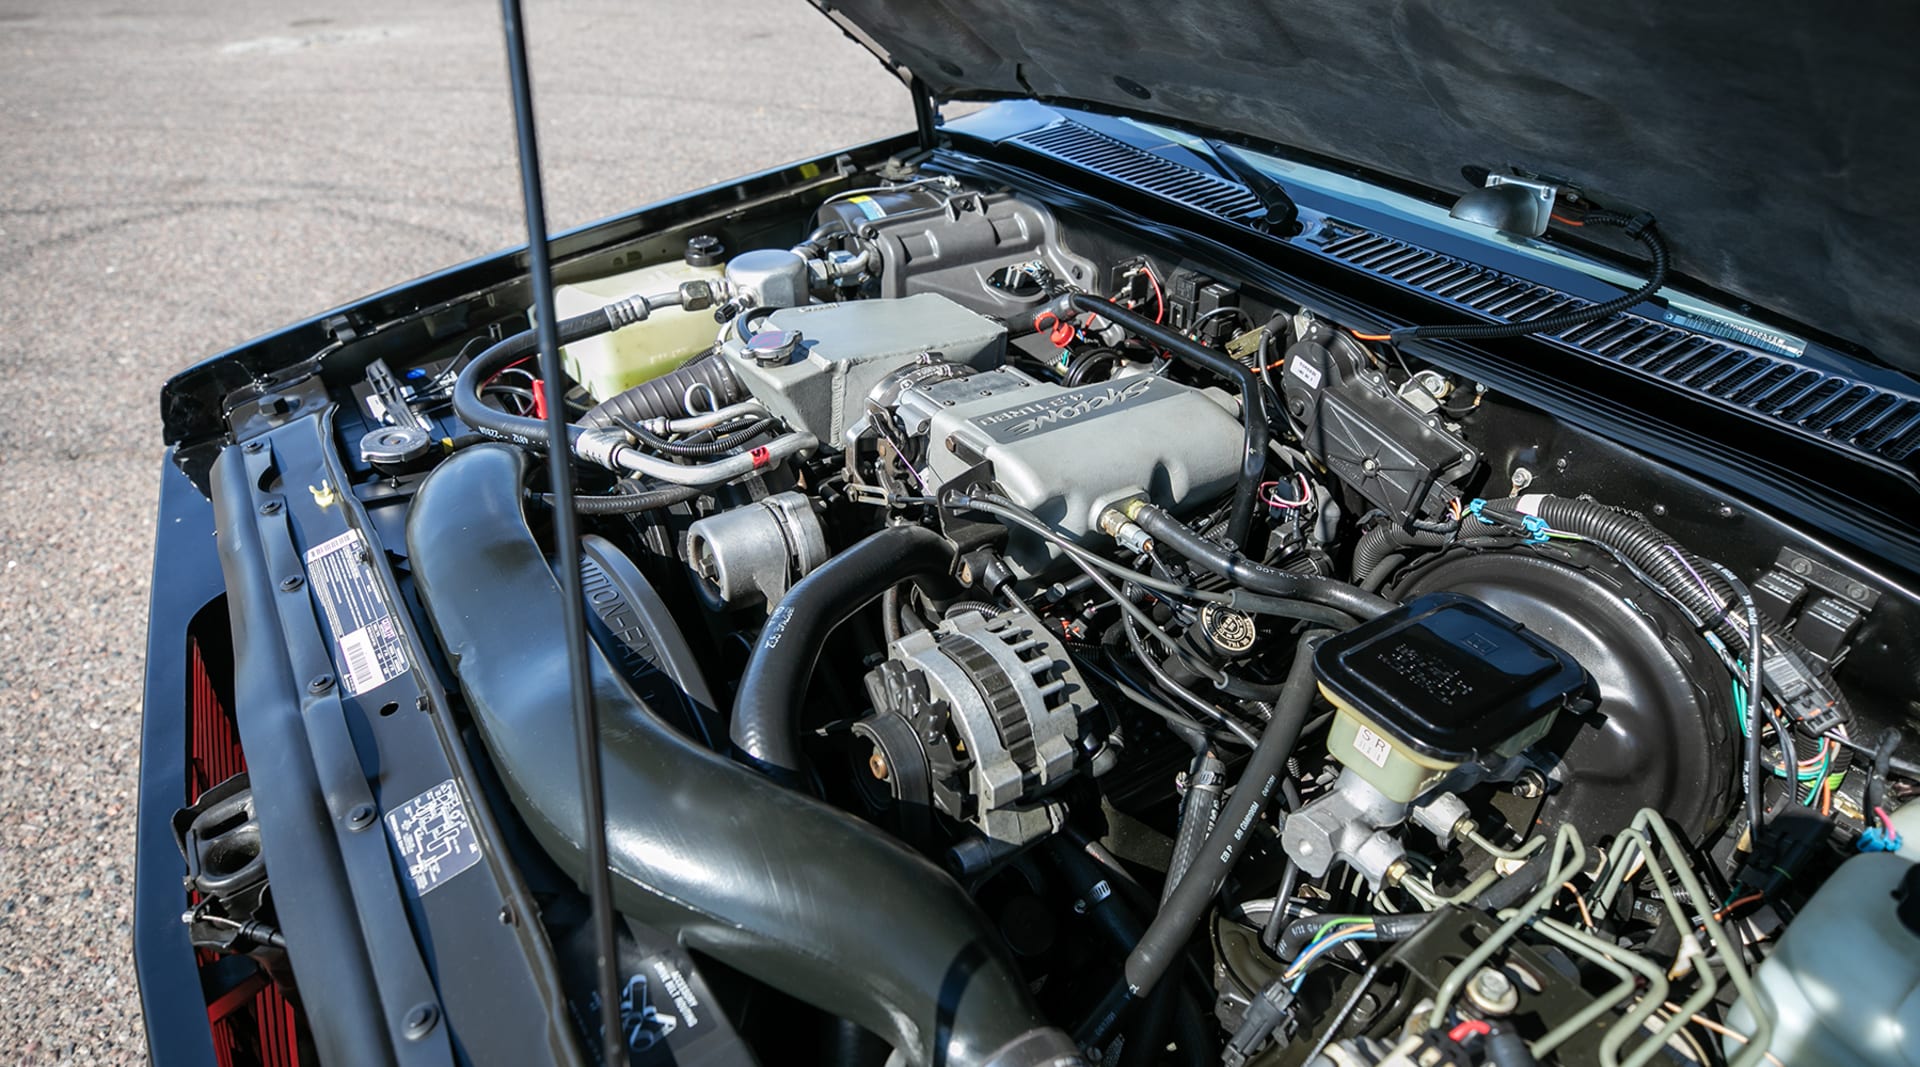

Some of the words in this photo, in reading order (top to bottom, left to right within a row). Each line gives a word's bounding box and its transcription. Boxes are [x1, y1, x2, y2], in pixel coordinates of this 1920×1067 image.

[1005, 376, 1154, 436] SYCLONE
[1361, 728, 1371, 741] S
[1374, 738, 1384, 751] R
